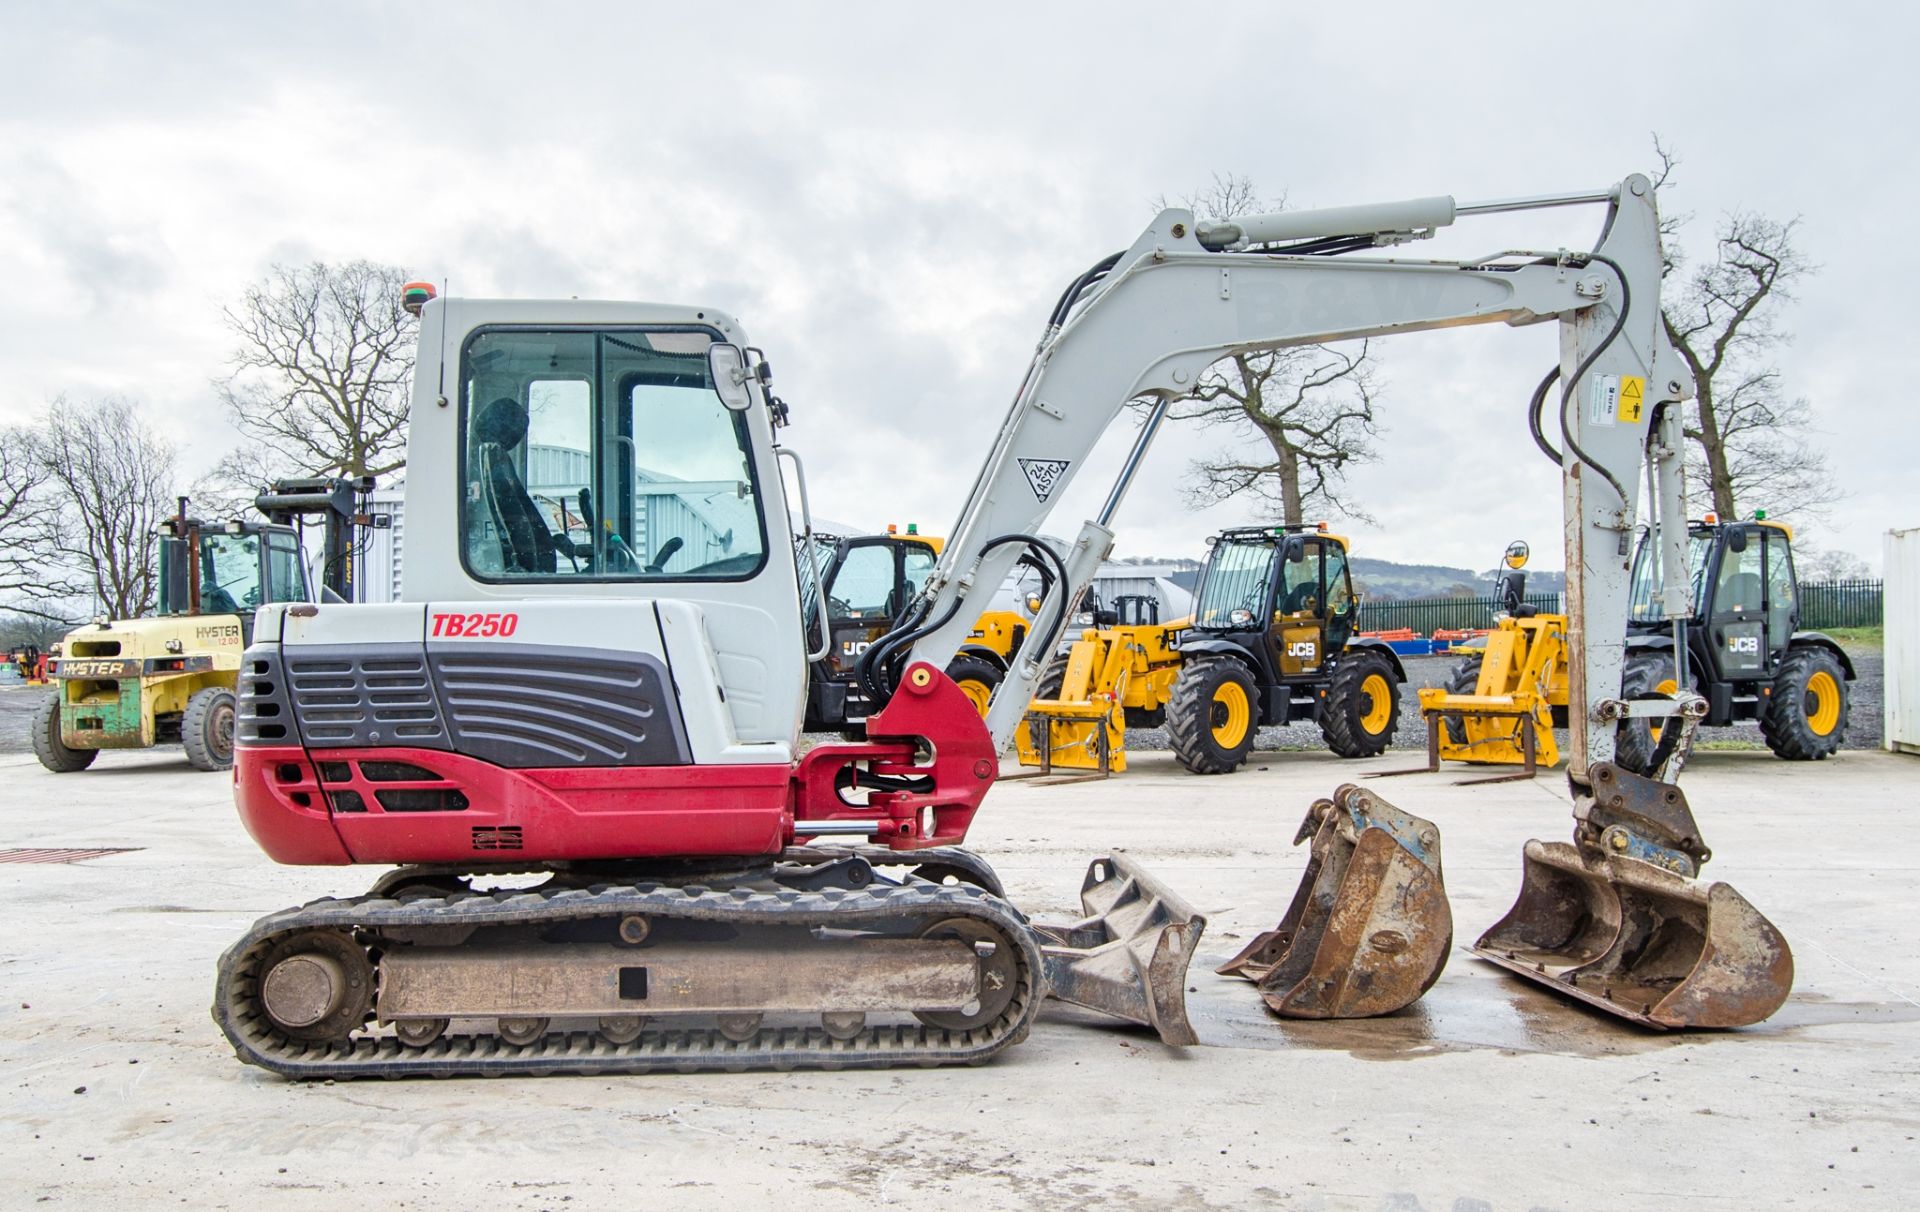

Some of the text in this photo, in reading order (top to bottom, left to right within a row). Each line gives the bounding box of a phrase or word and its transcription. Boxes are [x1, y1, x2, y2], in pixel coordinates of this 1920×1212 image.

[1030, 464, 1044, 480] 24
[196, 625, 239, 639] HYSTER
[432, 613, 519, 637] TB250
[1288, 642, 1315, 657] JCB
[1729, 637, 1759, 652] JCB
[63, 661, 125, 676] HYSTER
